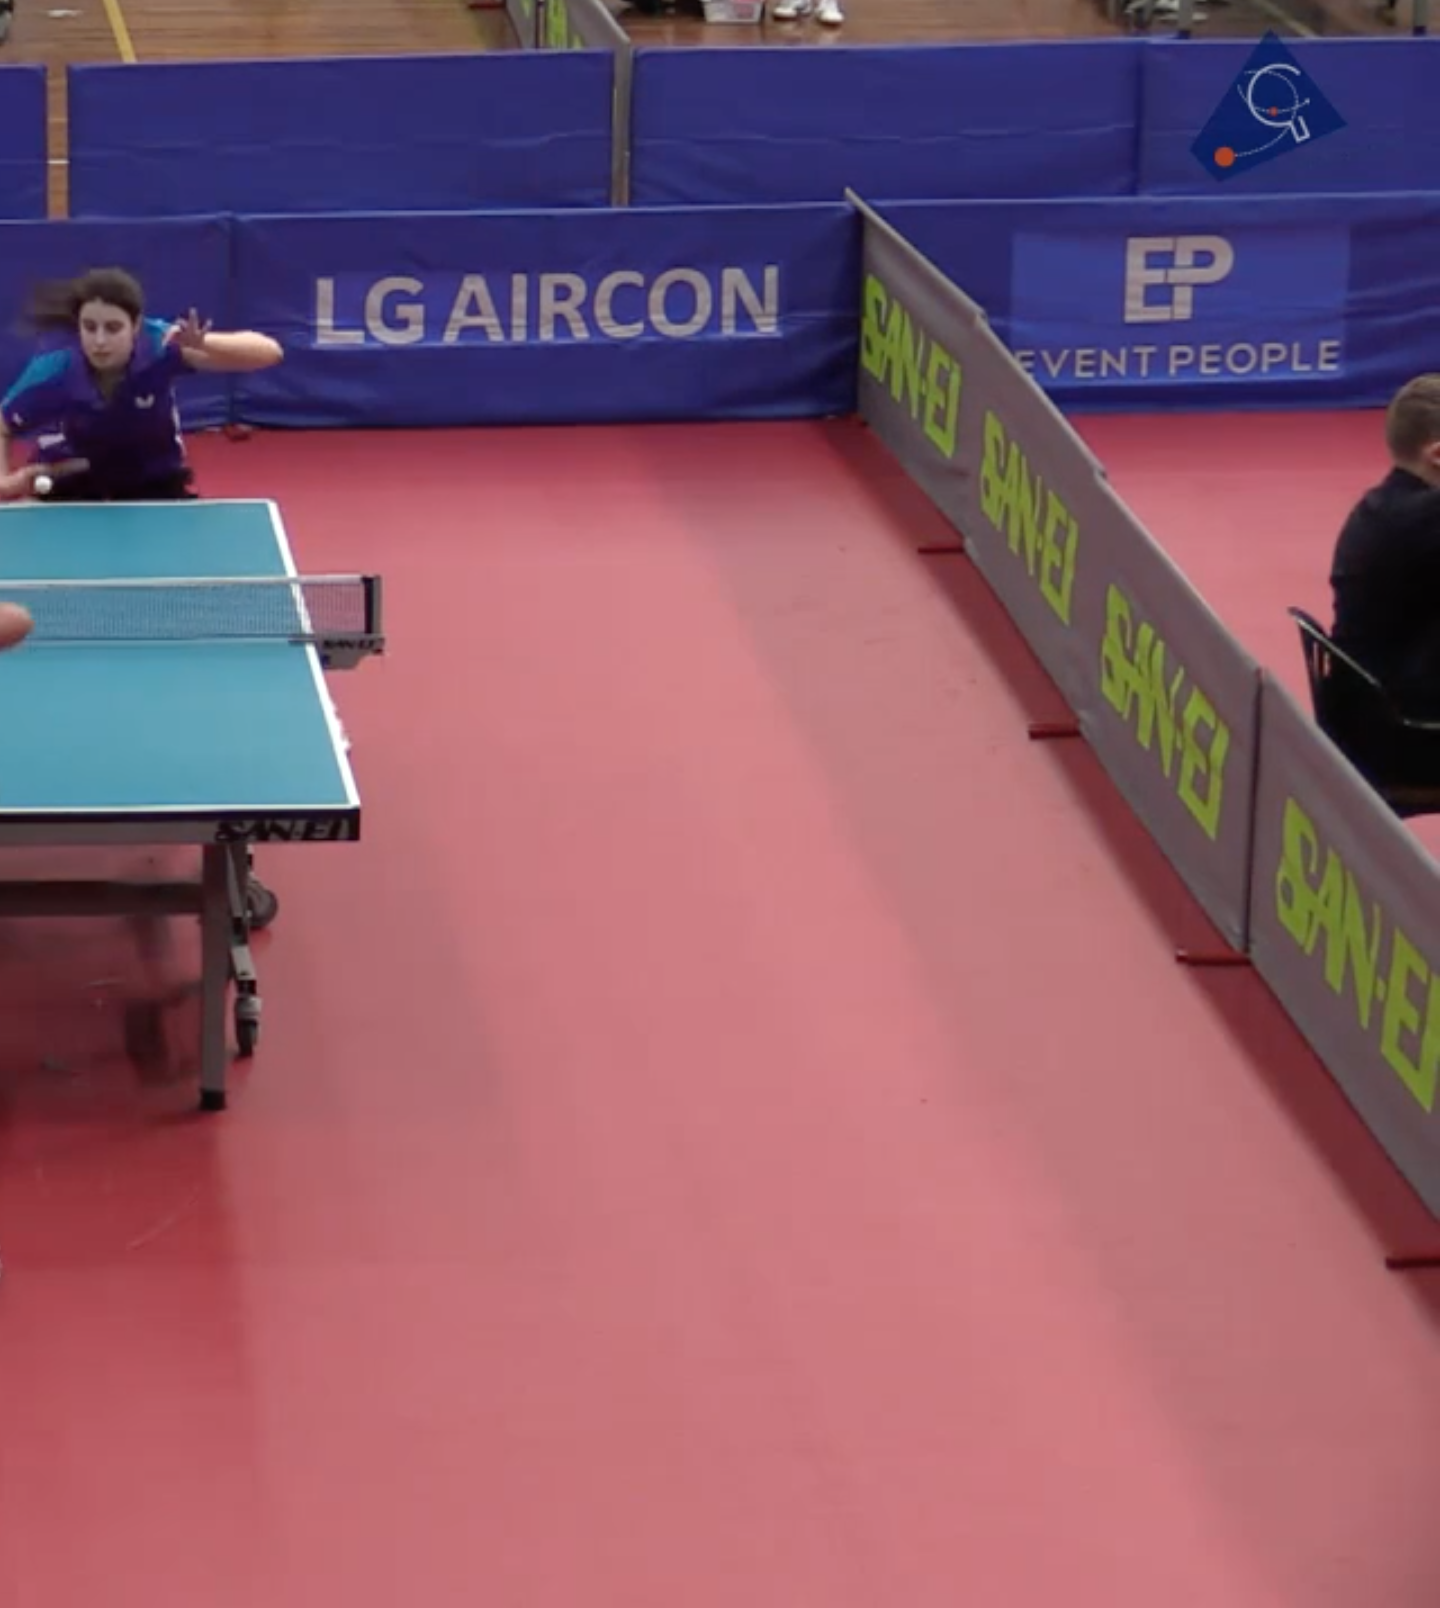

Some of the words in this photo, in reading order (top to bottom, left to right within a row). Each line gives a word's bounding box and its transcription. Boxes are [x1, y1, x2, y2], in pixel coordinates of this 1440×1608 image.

[316, 276, 425, 345] LG
[442, 264, 780, 343] AIRCON
[1123, 235, 1234, 324] EP
[1018, 344, 1158, 379] EVENT
[1169, 340, 1341, 377] PEOPLE
